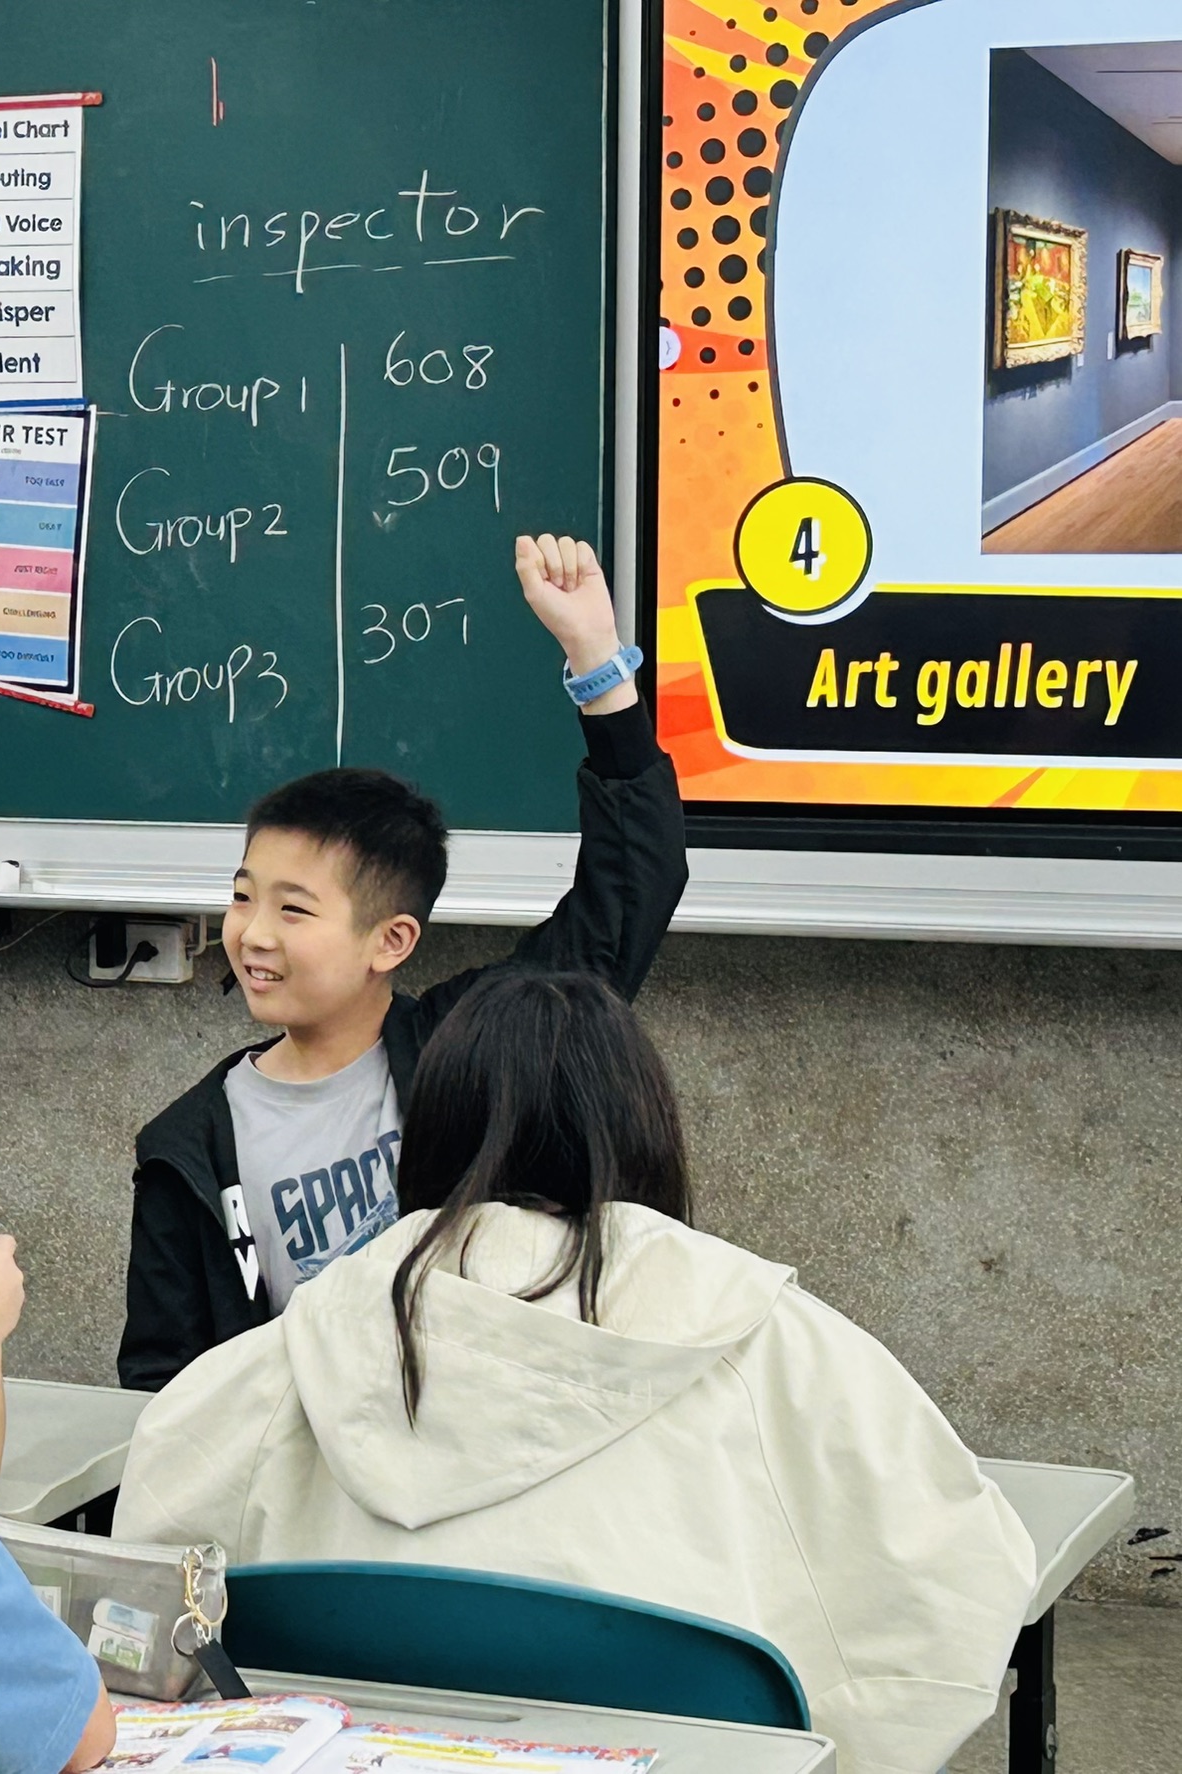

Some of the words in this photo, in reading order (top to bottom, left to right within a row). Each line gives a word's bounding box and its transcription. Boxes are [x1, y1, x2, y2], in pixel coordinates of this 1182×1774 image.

[13, 119, 70, 139] Chart
[6, 213, 63, 233] Voice
[190, 170, 544, 294] inspector
[129, 324, 280, 427] Group
[384, 331, 494, 390] 608
[21, 425, 68, 446] TEST
[387, 444, 500, 513] 509
[116, 467, 252, 564] Group
[788, 516, 820, 577] 4
[363, 598, 468, 664] 307
[806, 648, 899, 708] Art
[916, 642, 1138, 726] gallery
